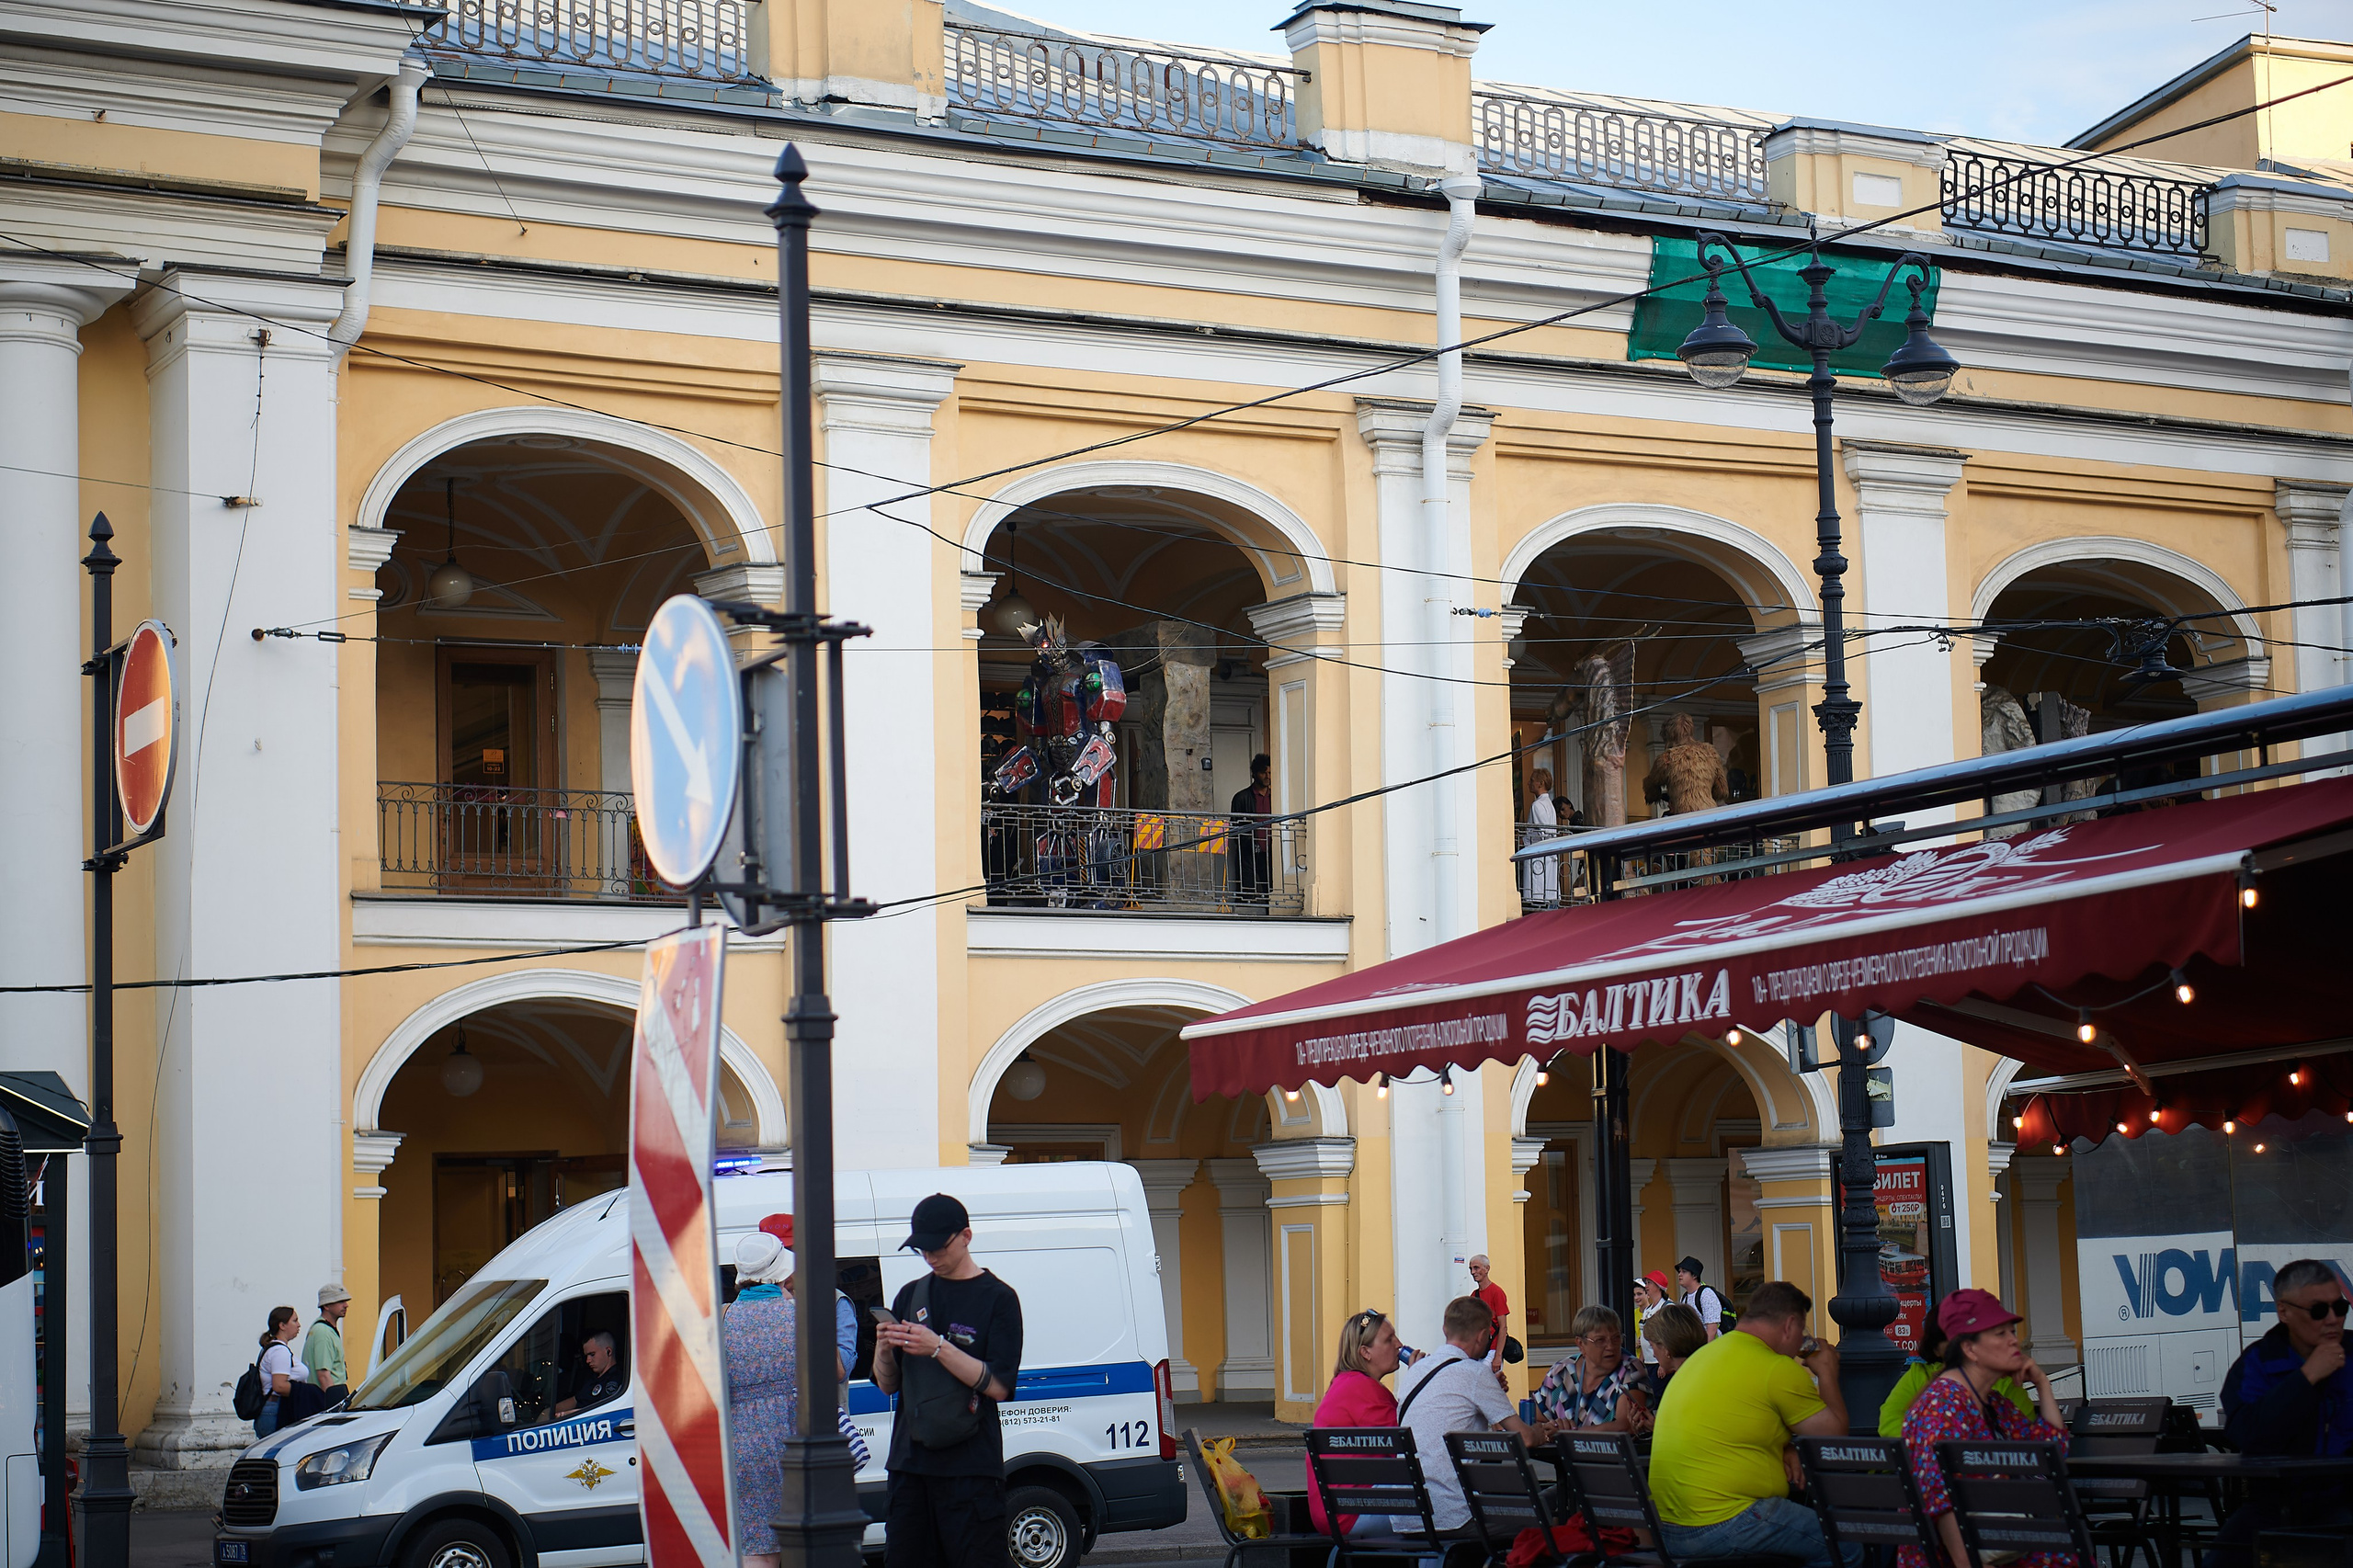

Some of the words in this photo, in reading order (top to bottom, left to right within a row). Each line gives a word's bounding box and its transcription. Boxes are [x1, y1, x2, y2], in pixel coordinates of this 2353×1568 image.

[1556, 968, 1731, 1040] БАЛТИКА
[1028, 1405, 1072, 1415] ДОВЕРИЯ:
[1023, 1415, 1061, 1424] 573-21-81
[2098, 1413, 2146, 1426] БАЛТИКА
[506, 1419, 613, 1452] ПОЛИЦИЯ
[1106, 1420, 1150, 1450] 112
[1337, 1435, 1393, 1449] БАЛТИКА
[1470, 1440, 1509, 1454] БАЛТИКА
[1580, 1440, 1619, 1455] БАЛТИКА
[1831, 1447, 1887, 1462] БАЛТИКА
[1973, 1451, 2039, 1467] БАЛТИКА
